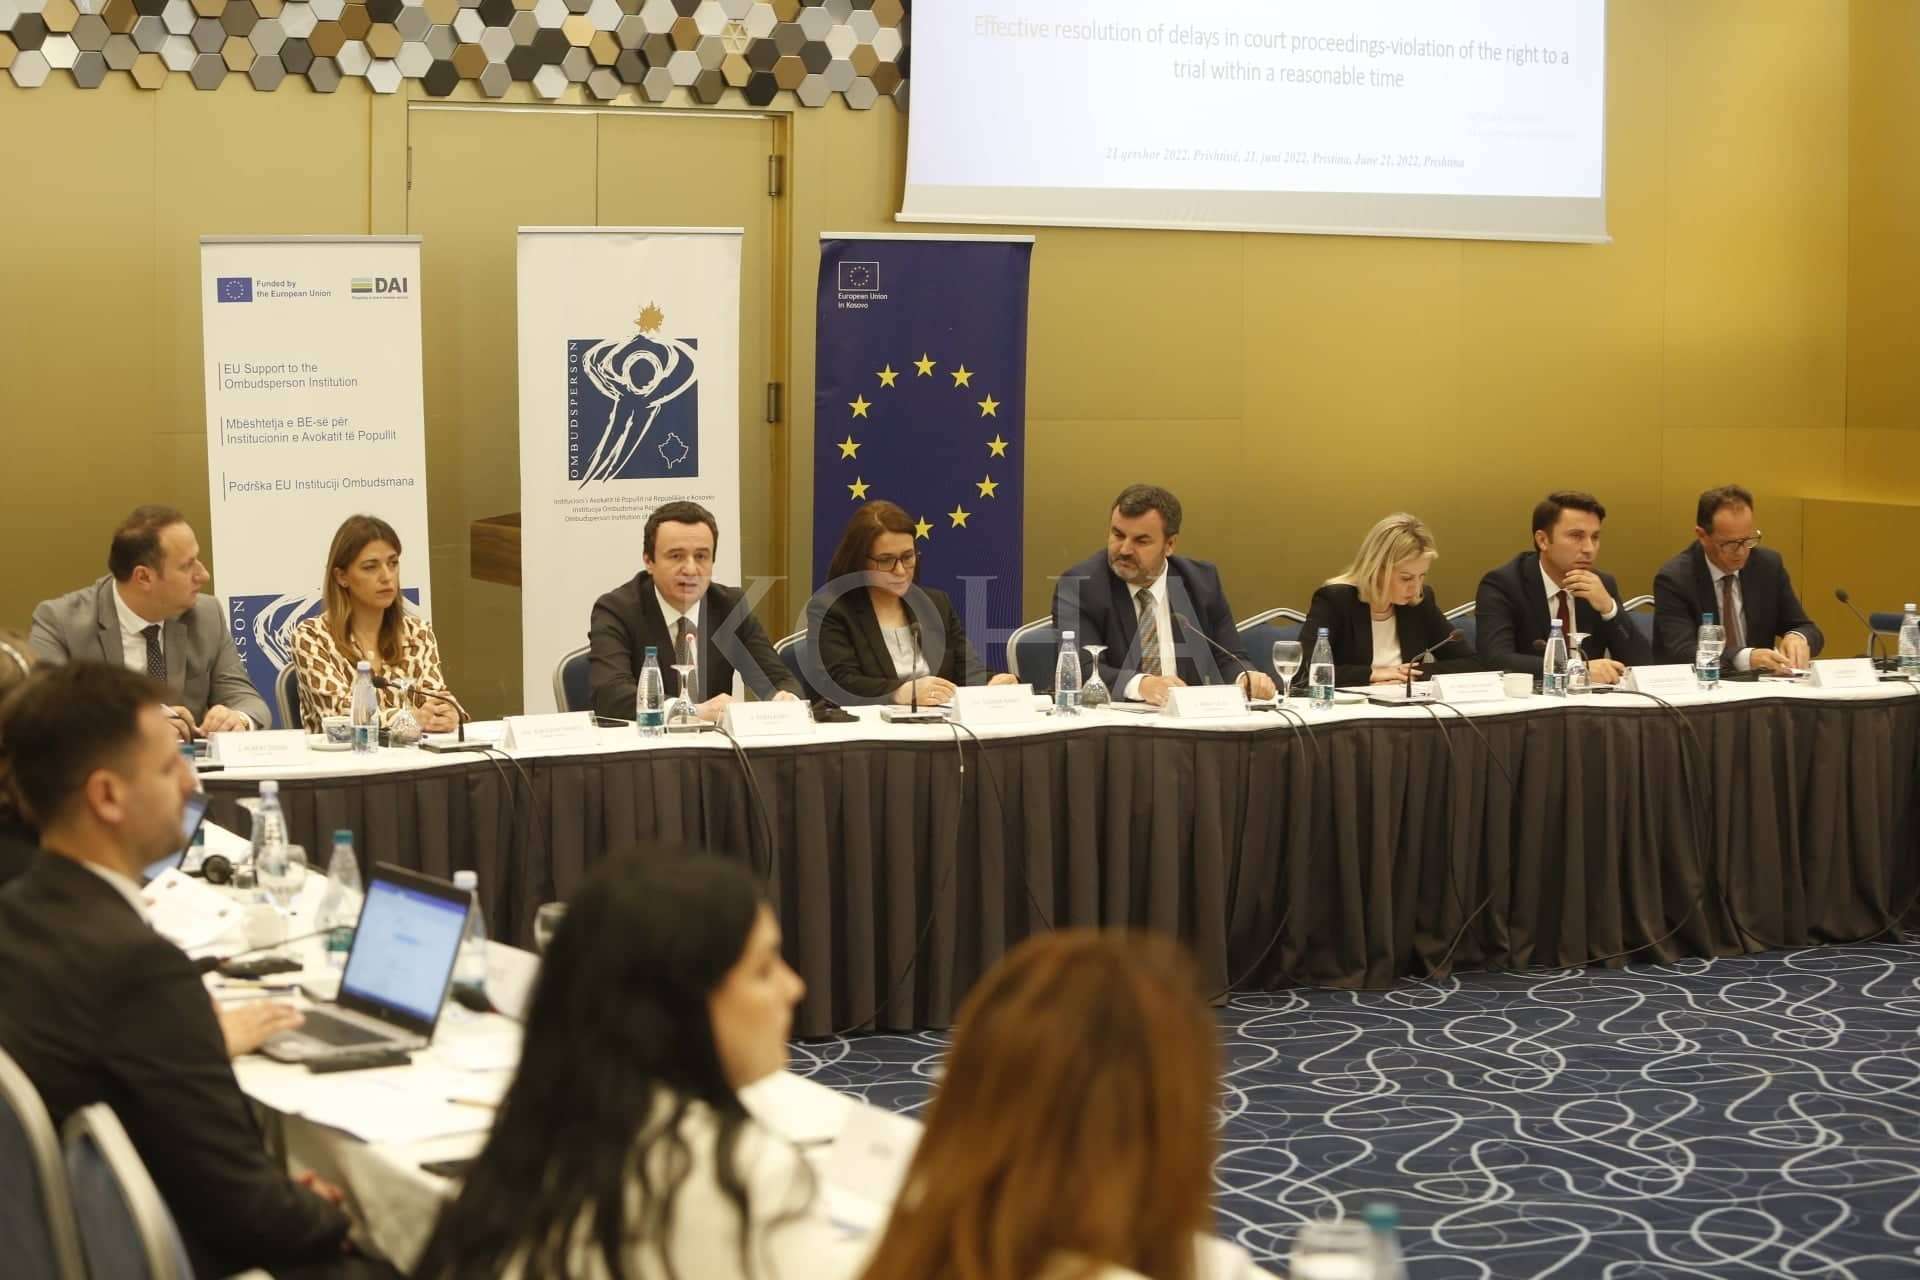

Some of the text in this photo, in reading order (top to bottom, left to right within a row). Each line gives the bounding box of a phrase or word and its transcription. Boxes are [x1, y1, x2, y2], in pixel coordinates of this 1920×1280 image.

[975, 16, 1570, 67] Effective resolution of delays in court proceedings-violation of the right to a
[1173, 59, 1405, 88] trial within a reasonable time
[256, 280, 296, 289] Funded by
[375, 277, 408, 293] DAI
[256, 289, 331, 300] the European Union
[839, 292, 888, 302] European Union
[224, 362, 318, 376] EU Support to the
[224, 376, 357, 391] Ombudsperson Institution
[570, 342, 579, 479] OMBUDSPERSON
[226, 416, 349, 430] Mbështetja e BE-së për
[227, 430, 396, 445] Institucionin e Avokatit të Popullit
[229, 475, 414, 492] Podrška EU Instituciji Ombudsmana
